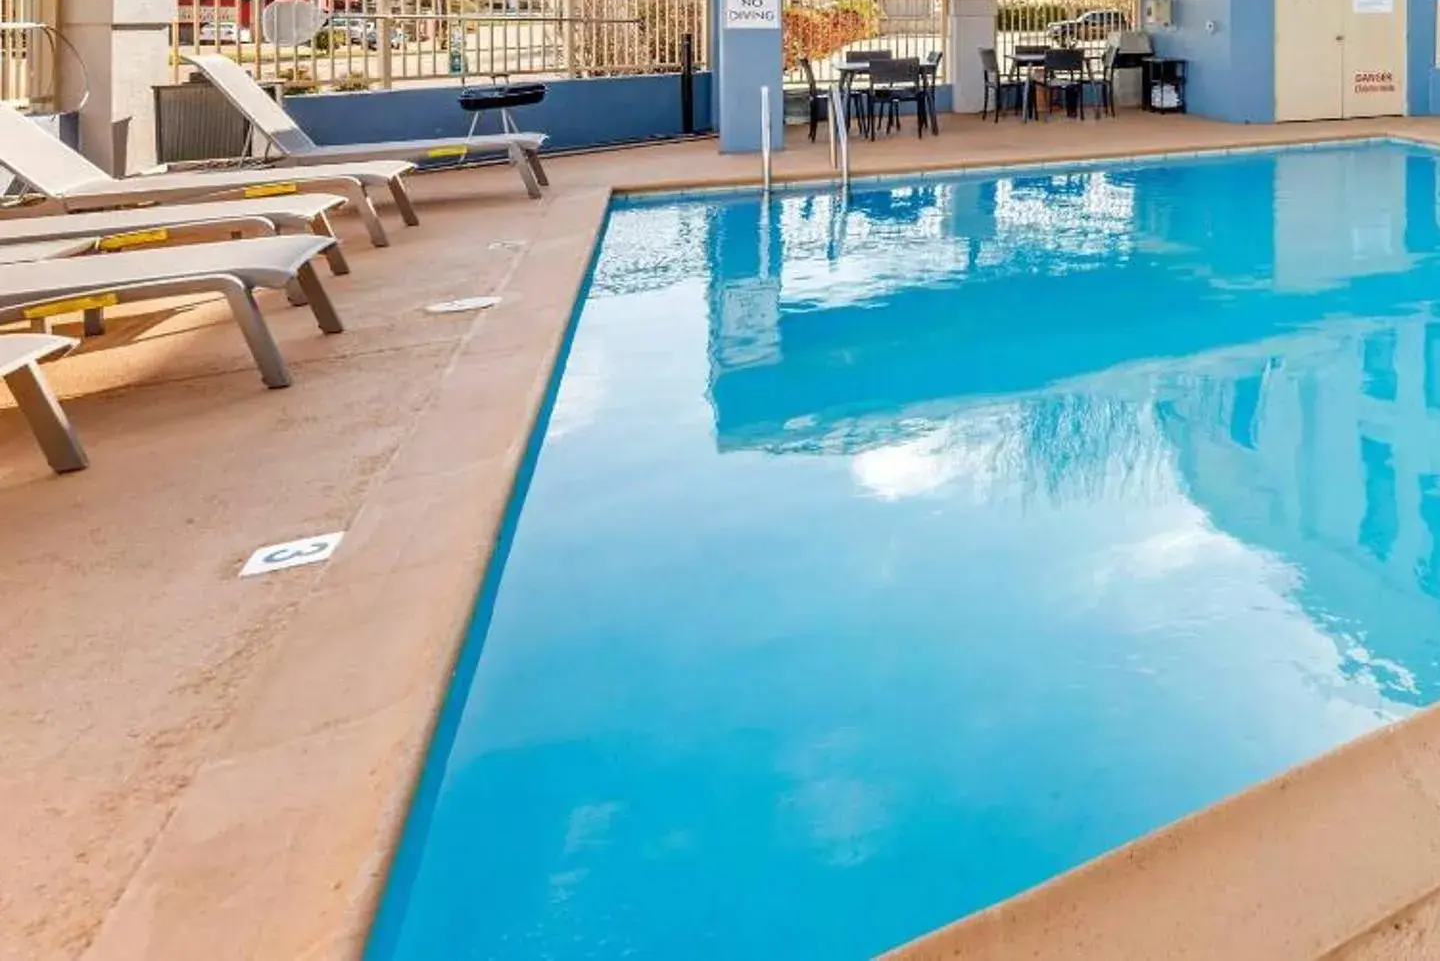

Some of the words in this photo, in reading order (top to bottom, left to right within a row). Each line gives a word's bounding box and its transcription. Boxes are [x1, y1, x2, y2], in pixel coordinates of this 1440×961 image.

[729, 10, 775, 21] DIVING
[1355, 72, 1392, 83] DANGER
[262, 542, 329, 563] 3
